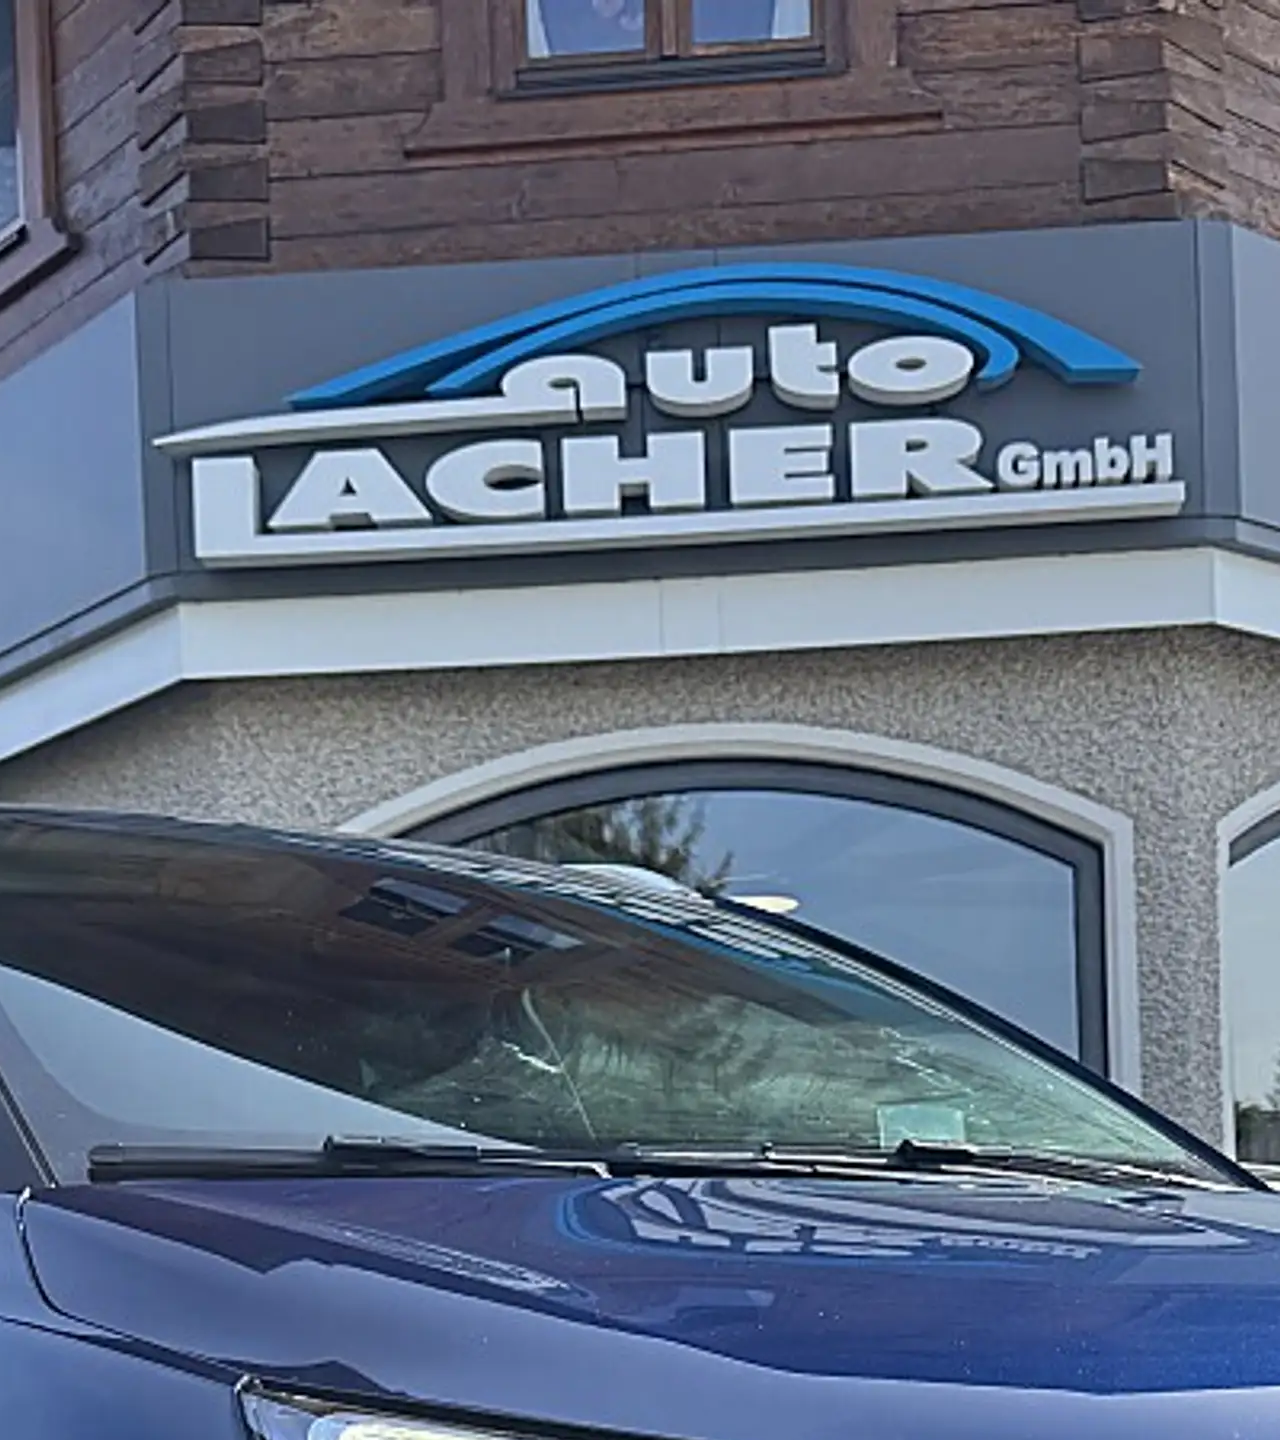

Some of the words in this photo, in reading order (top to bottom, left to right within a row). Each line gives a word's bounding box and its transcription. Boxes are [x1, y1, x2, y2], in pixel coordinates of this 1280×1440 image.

[500, 322, 974, 418] auto
[192, 416, 997, 568] LACHER
[997, 432, 1174, 487] GmbH
